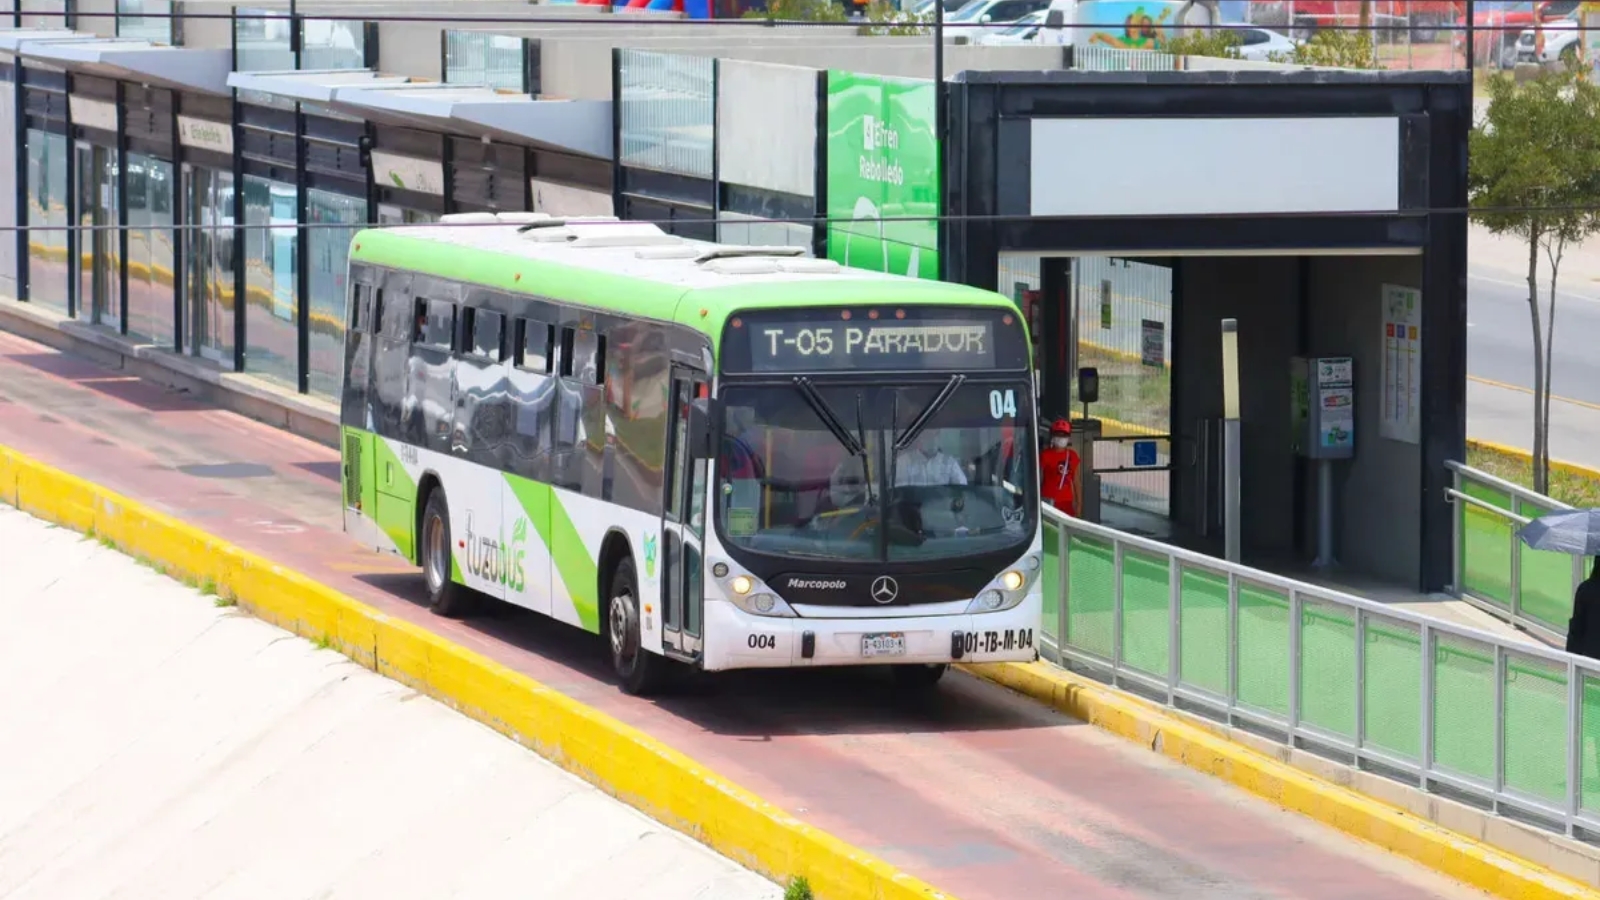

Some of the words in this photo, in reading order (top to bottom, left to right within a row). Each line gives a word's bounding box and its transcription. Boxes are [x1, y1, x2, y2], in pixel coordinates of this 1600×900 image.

[859, 154, 903, 186] Rebolledo
[764, 328, 833, 356] T-05
[845, 325, 986, 354] PARADOR
[989, 388, 1018, 419] 04
[787, 577, 847, 591] Marcopolo
[747, 633, 776, 650] 004
